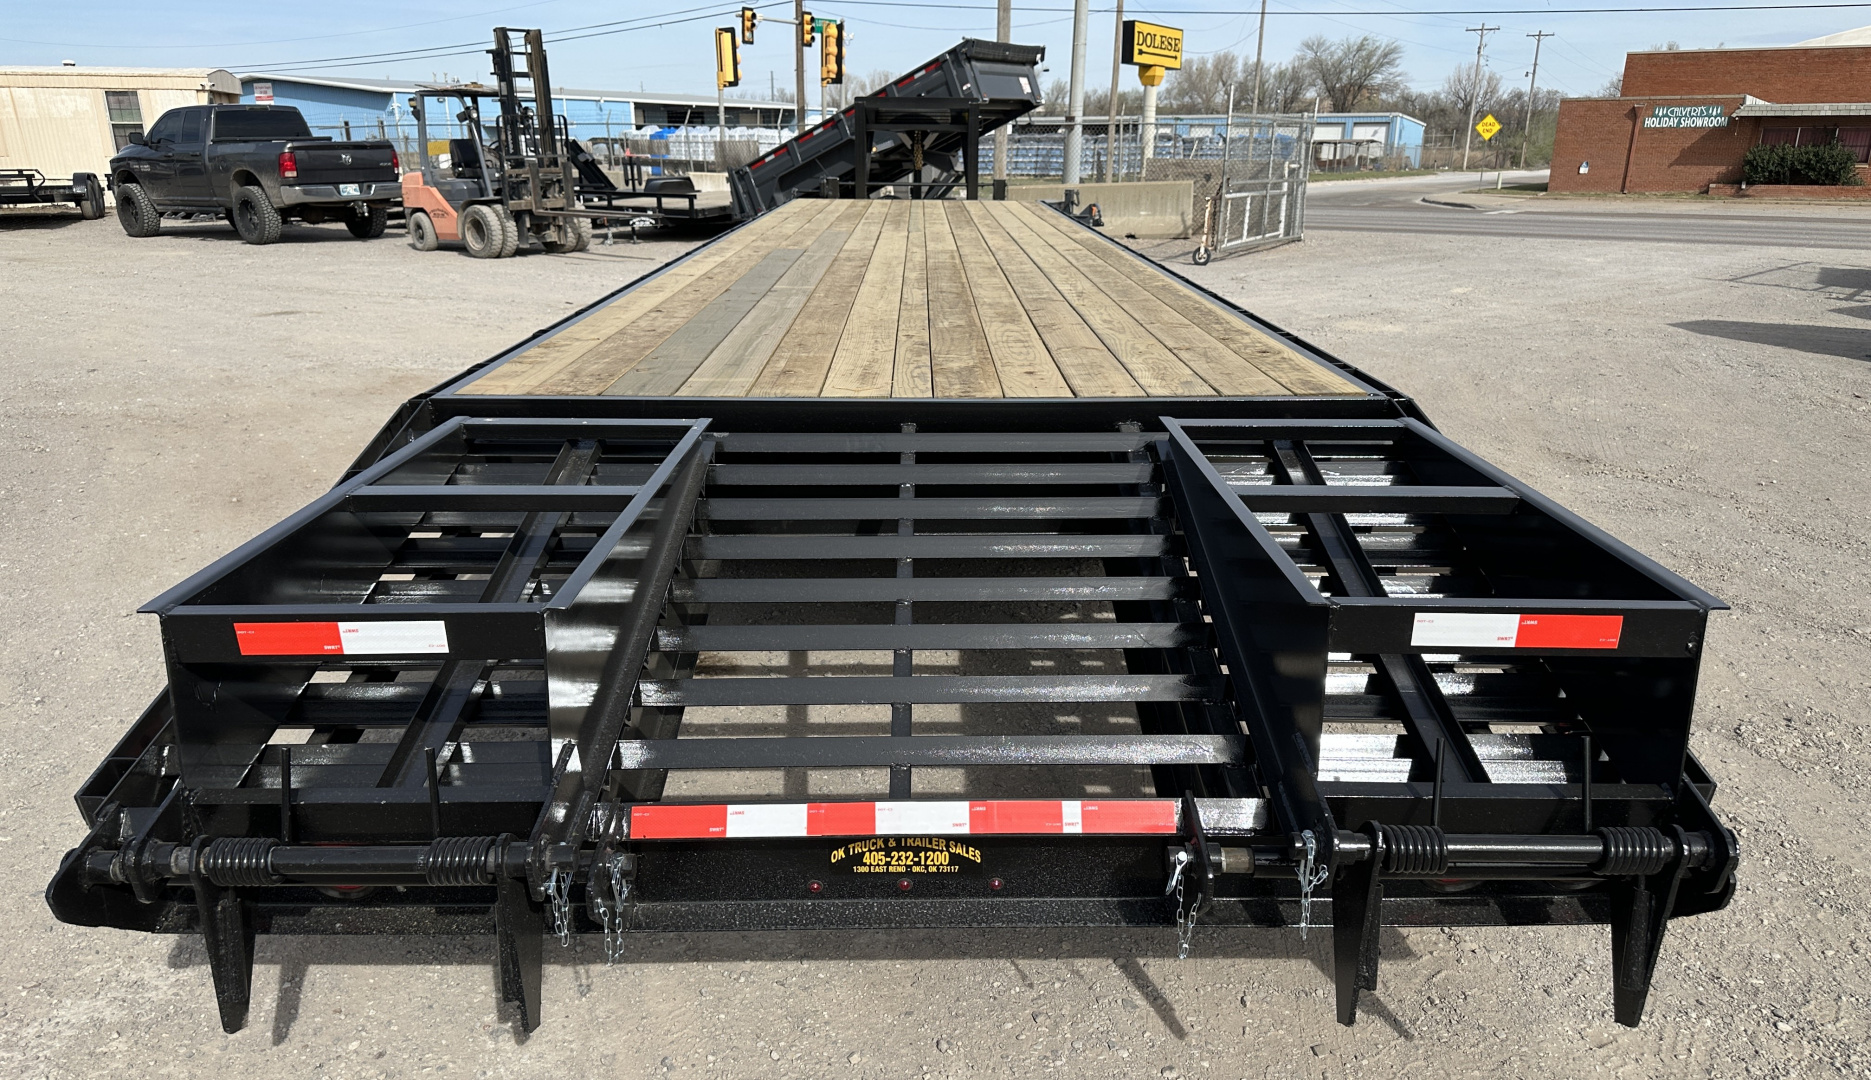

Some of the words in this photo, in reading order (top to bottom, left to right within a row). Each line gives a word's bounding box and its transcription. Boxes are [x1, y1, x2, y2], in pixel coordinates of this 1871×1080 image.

[1136, 31, 1180, 52] DOLESE
[1644, 117, 1679, 127] HOLIDAY
[1680, 117, 1728, 127] SHOWROOM
[830, 846, 846, 863] OK
[848, 838, 885, 855] TRUCK
[888, 837, 896, 847] &
[949, 840, 982, 863] SALES
[863, 851, 949, 866] 405-232-1200
